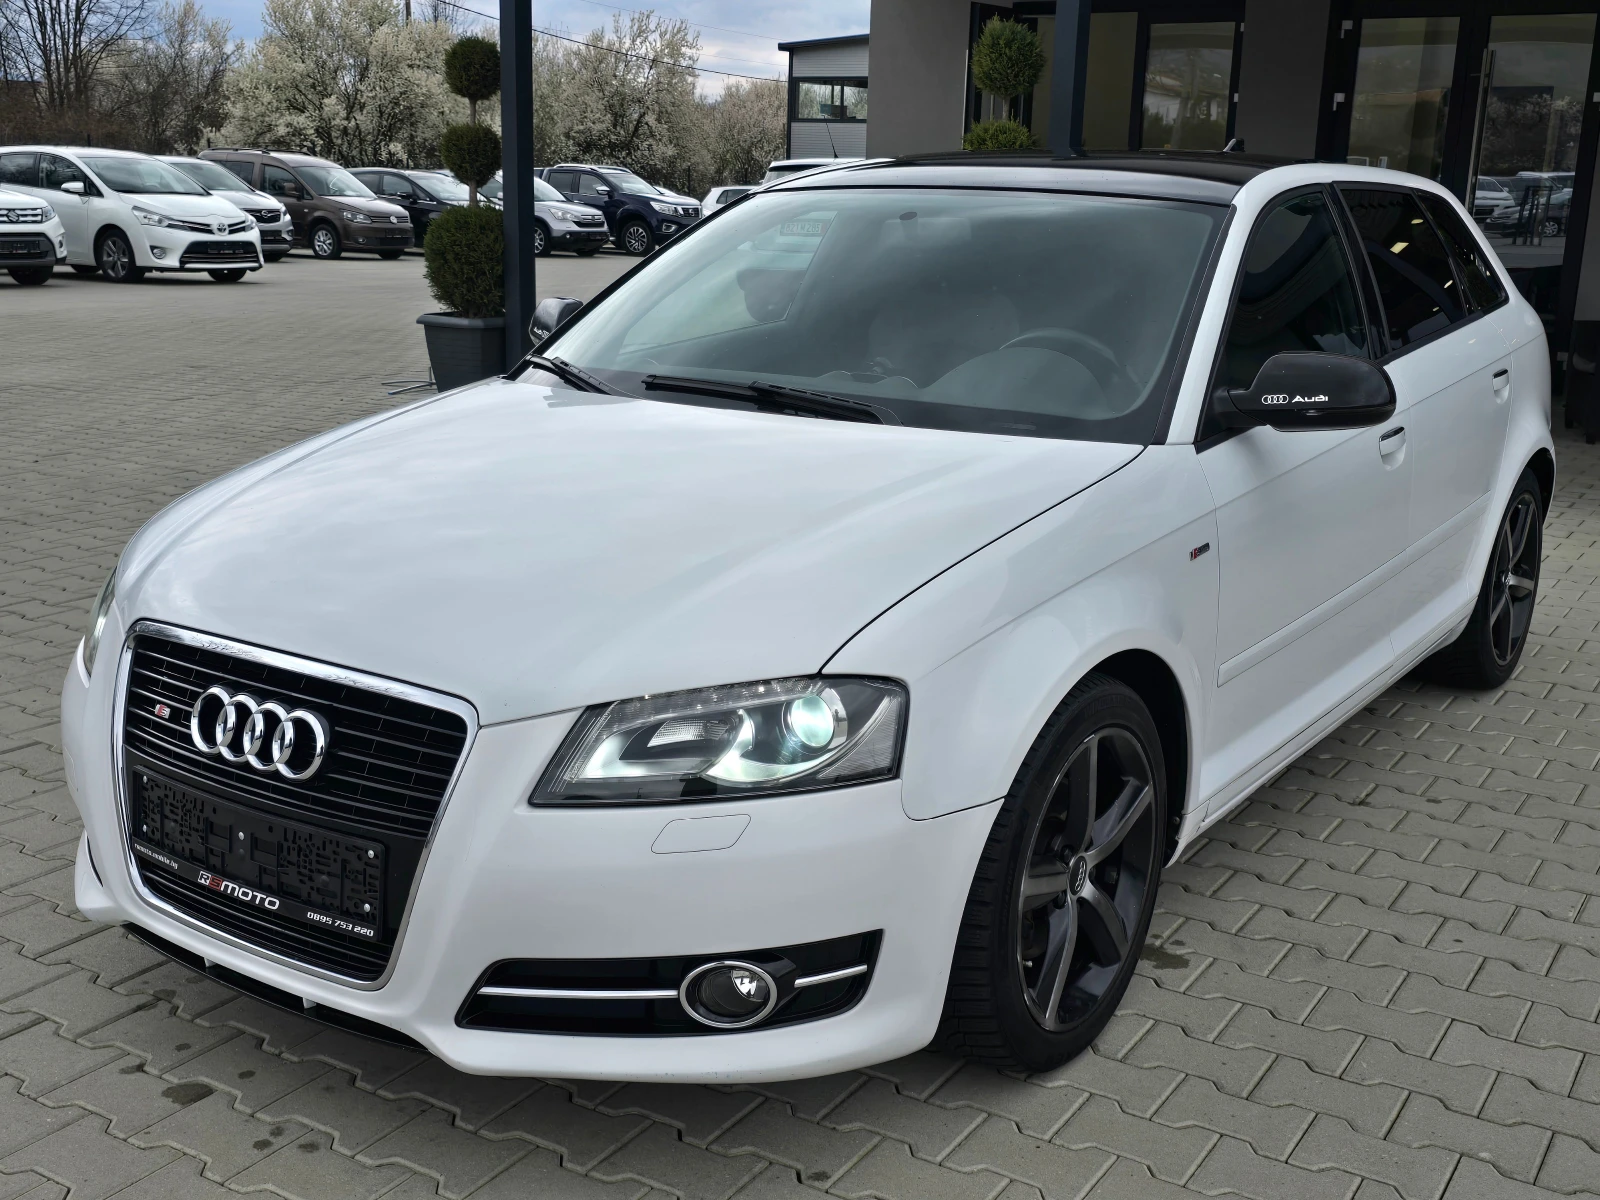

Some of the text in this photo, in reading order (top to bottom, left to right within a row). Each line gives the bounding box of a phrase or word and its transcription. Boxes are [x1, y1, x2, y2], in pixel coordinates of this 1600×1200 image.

[1291, 394, 1329, 403] Audi
[306, 911, 374, 937] 0895 753 220
